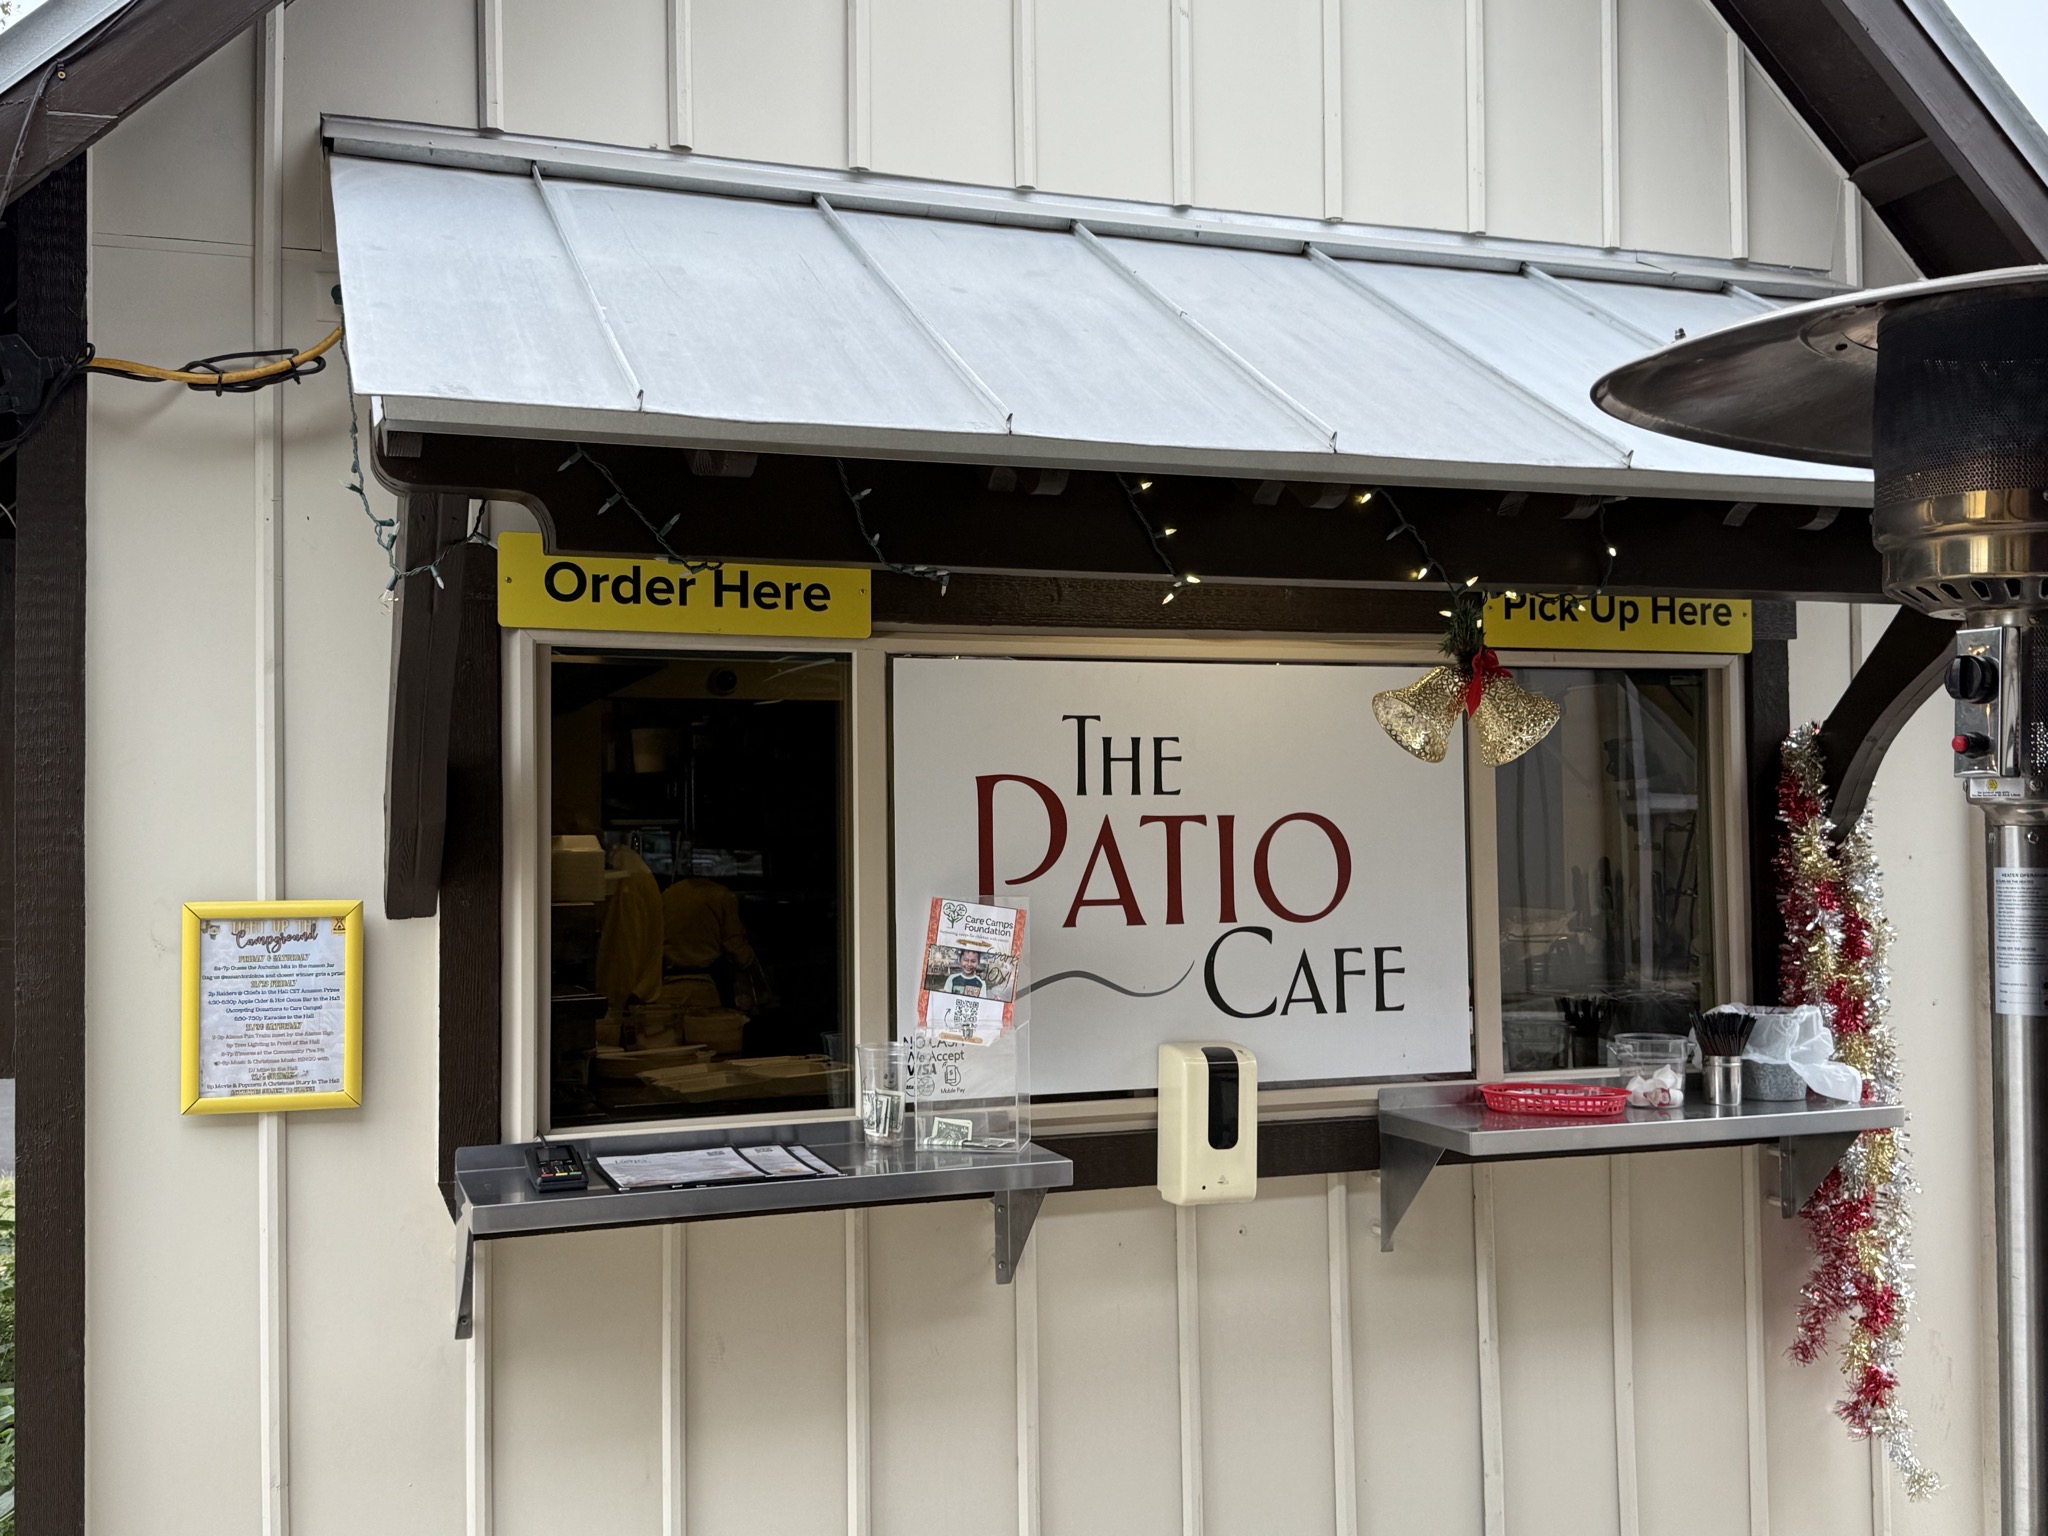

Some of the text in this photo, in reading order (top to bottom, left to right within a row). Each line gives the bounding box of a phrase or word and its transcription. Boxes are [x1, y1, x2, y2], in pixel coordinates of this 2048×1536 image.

[545, 561, 831, 612] Order Here
[1504, 594, 1732, 631] Pick Up Here
[1062, 715, 1183, 796] THE
[975, 774, 1352, 928] PATIO
[965, 924, 1011, 937] Foundation
[966, 915, 1013, 929] Care Camps
[231, 923, 318, 953] Campground
[987, 947, 1019, 966] Spark
[1204, 926, 1405, 1019] CAFE
[929, 1050, 965, 1063] Accept
[907, 1063, 937, 1076] VISA
[956, 1086, 965, 1094] Pay
